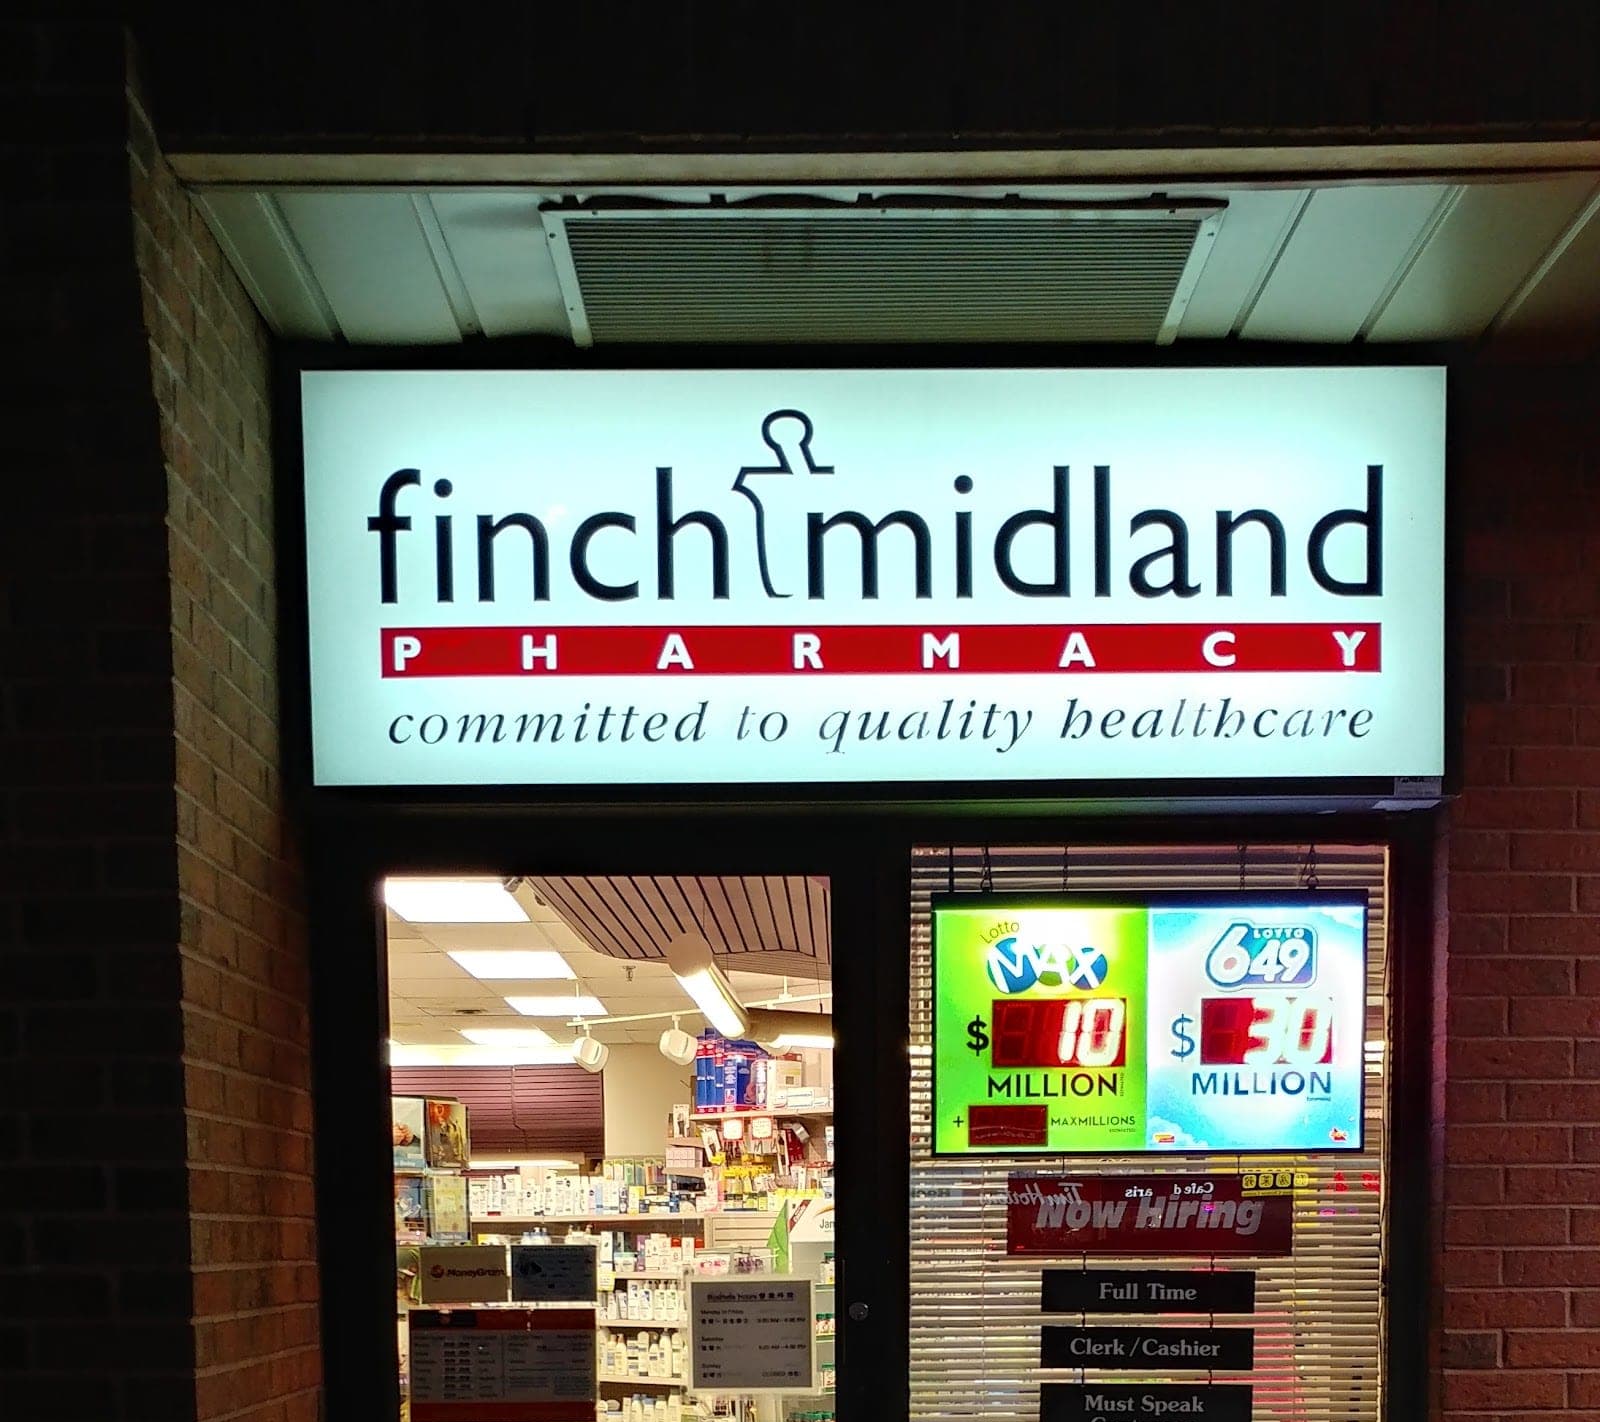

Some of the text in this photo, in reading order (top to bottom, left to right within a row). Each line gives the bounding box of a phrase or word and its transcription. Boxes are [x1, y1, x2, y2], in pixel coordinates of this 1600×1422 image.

[367, 464, 1384, 604] finch midland
[392, 630, 1367, 672] PHARMACY
[388, 697, 1375, 755] committed to quality healthcare
[979, 920, 1020, 944] Lotto
[1253, 927, 1305, 939] LOTTO
[987, 936, 1108, 994] MAX
[1057, 998, 1126, 1066] 10
[987, 1073, 1118, 1098] MILLION
[1192, 1071, 1331, 1096] MILLION
[1051, 1115, 1136, 1126] MAXMILLIONS
[1135, 1195, 1264, 1236] Hiring
[1099, 1283, 1198, 1301] Full Time
[1084, 1395, 1205, 1416] Must Speak
